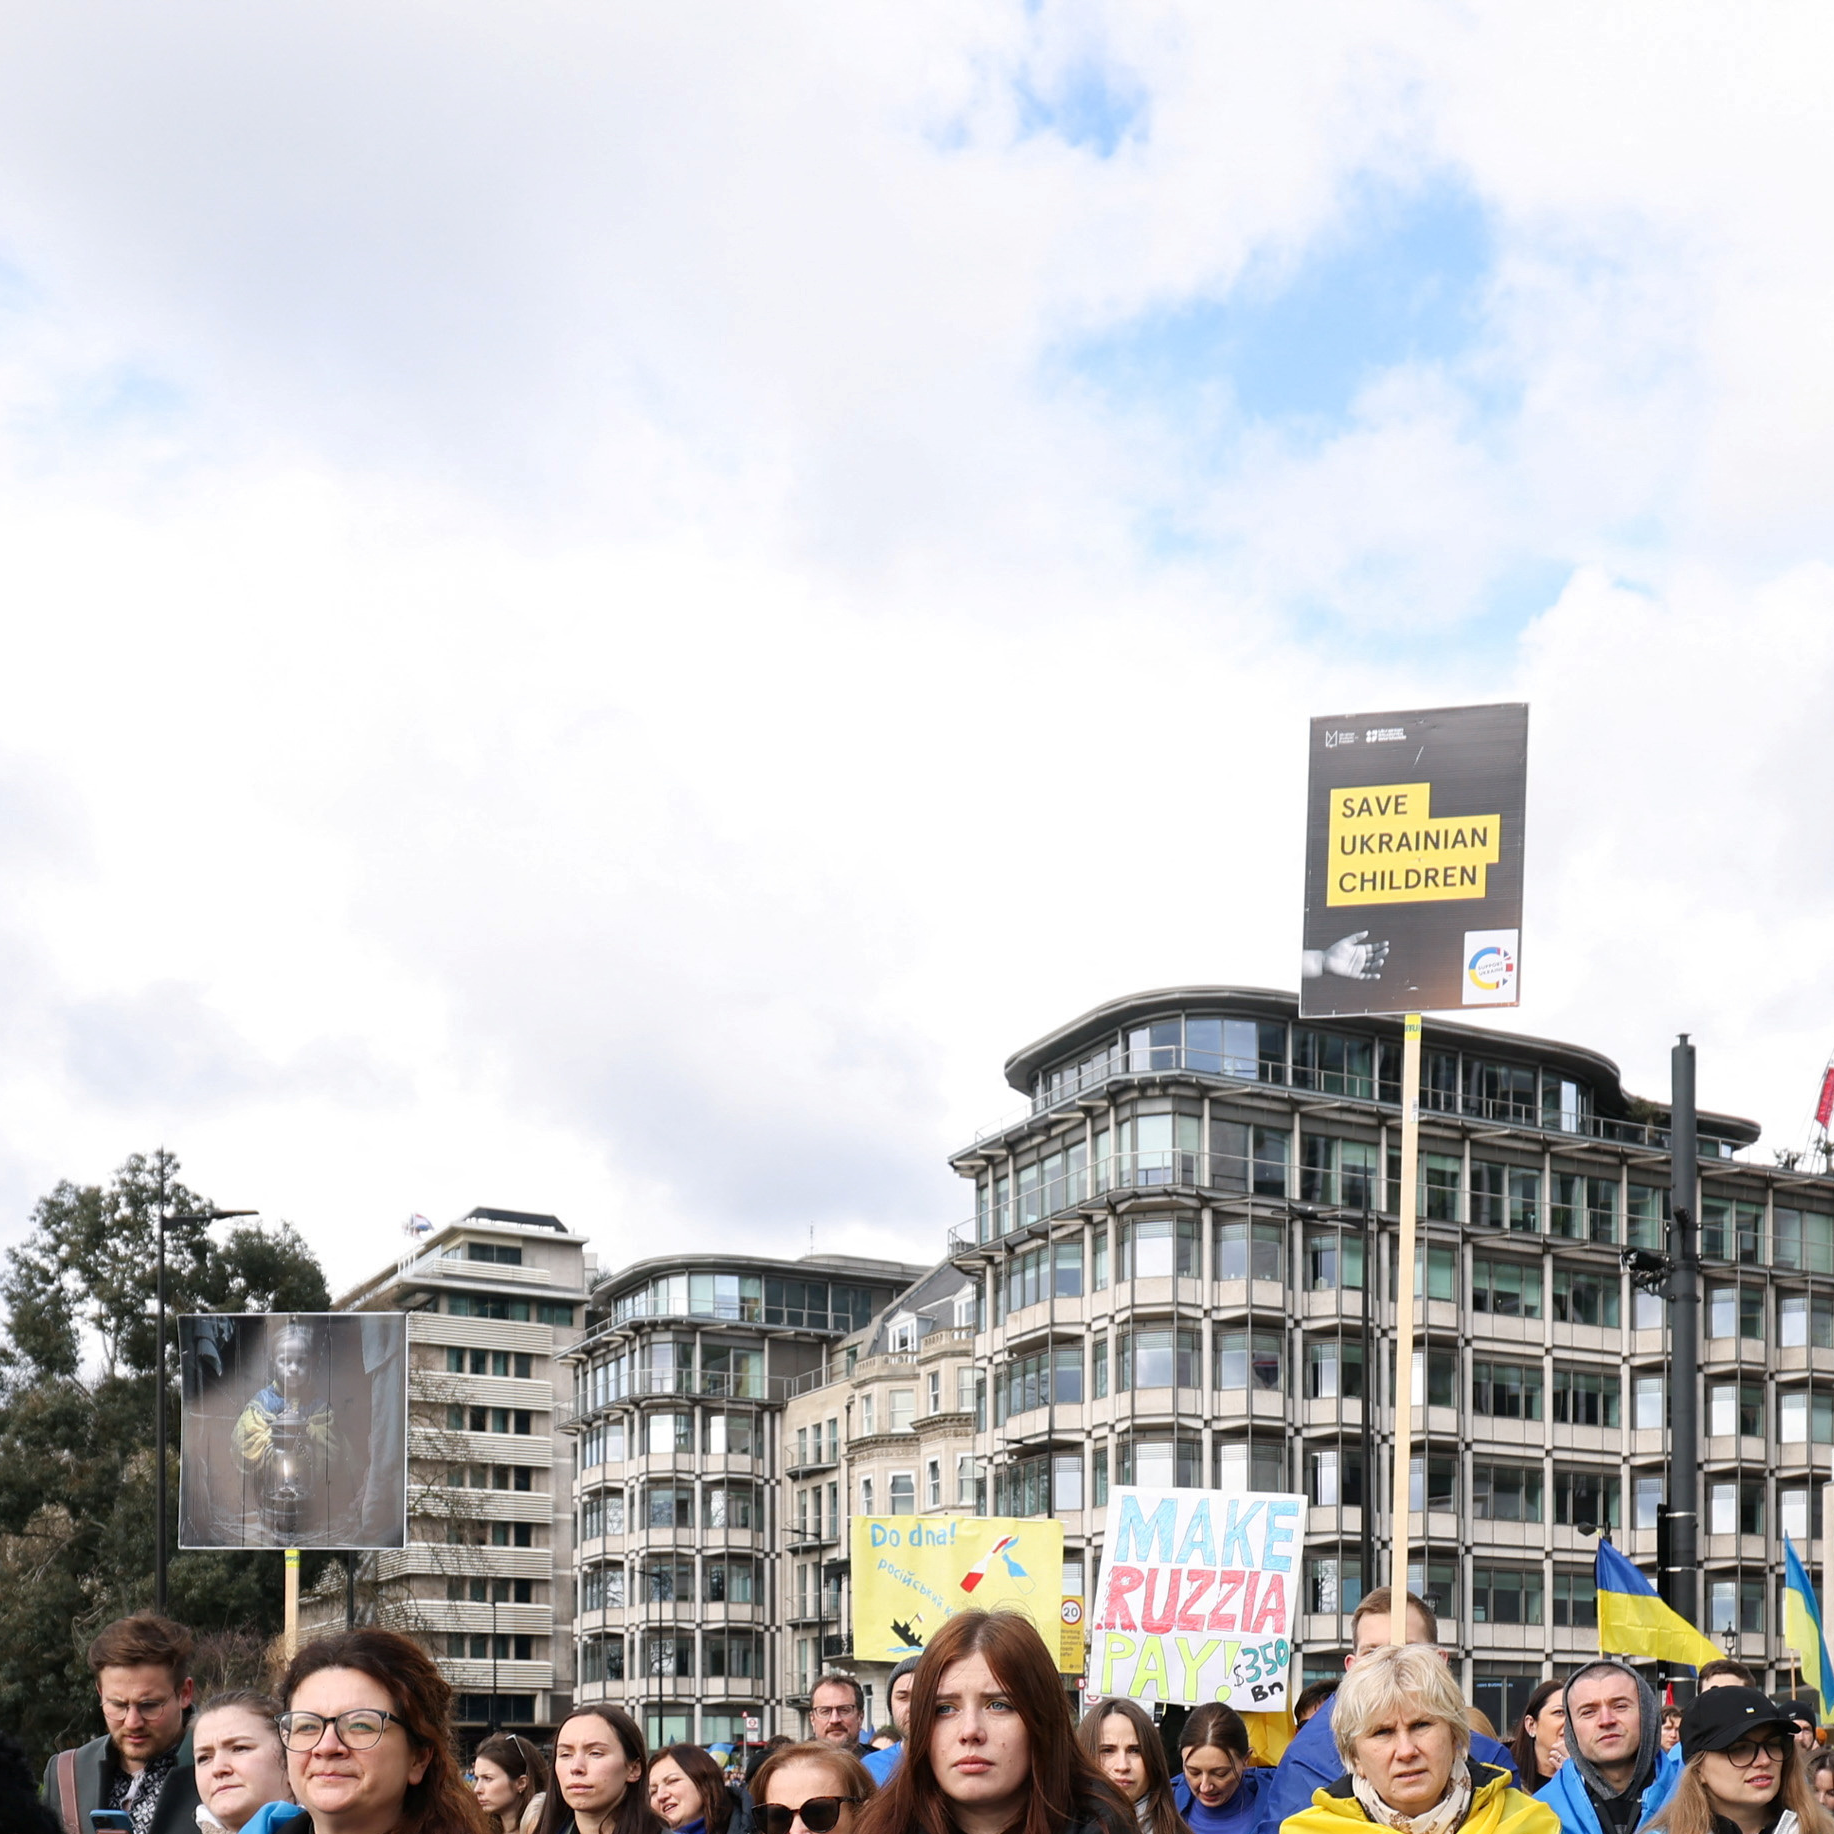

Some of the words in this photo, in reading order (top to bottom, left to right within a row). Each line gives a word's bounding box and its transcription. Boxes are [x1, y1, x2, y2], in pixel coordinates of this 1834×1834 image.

[1341, 794, 1408, 818] SAVE
[1340, 826, 1488, 856] UKRAINIAN
[1338, 864, 1477, 893] CHILDREN
[871, 1522, 901, 1548] Do
[908, 1521, 957, 1547] dna!
[1114, 1494, 1300, 1573] MAKE
[1063, 1607, 1079, 1618] 20
[1101, 1565, 1286, 1635] RUZZIA
[1100, 1632, 1242, 1704] PAY!
[1233, 1637, 1289, 1687] $350
[1250, 1681, 1284, 1703] Bn
